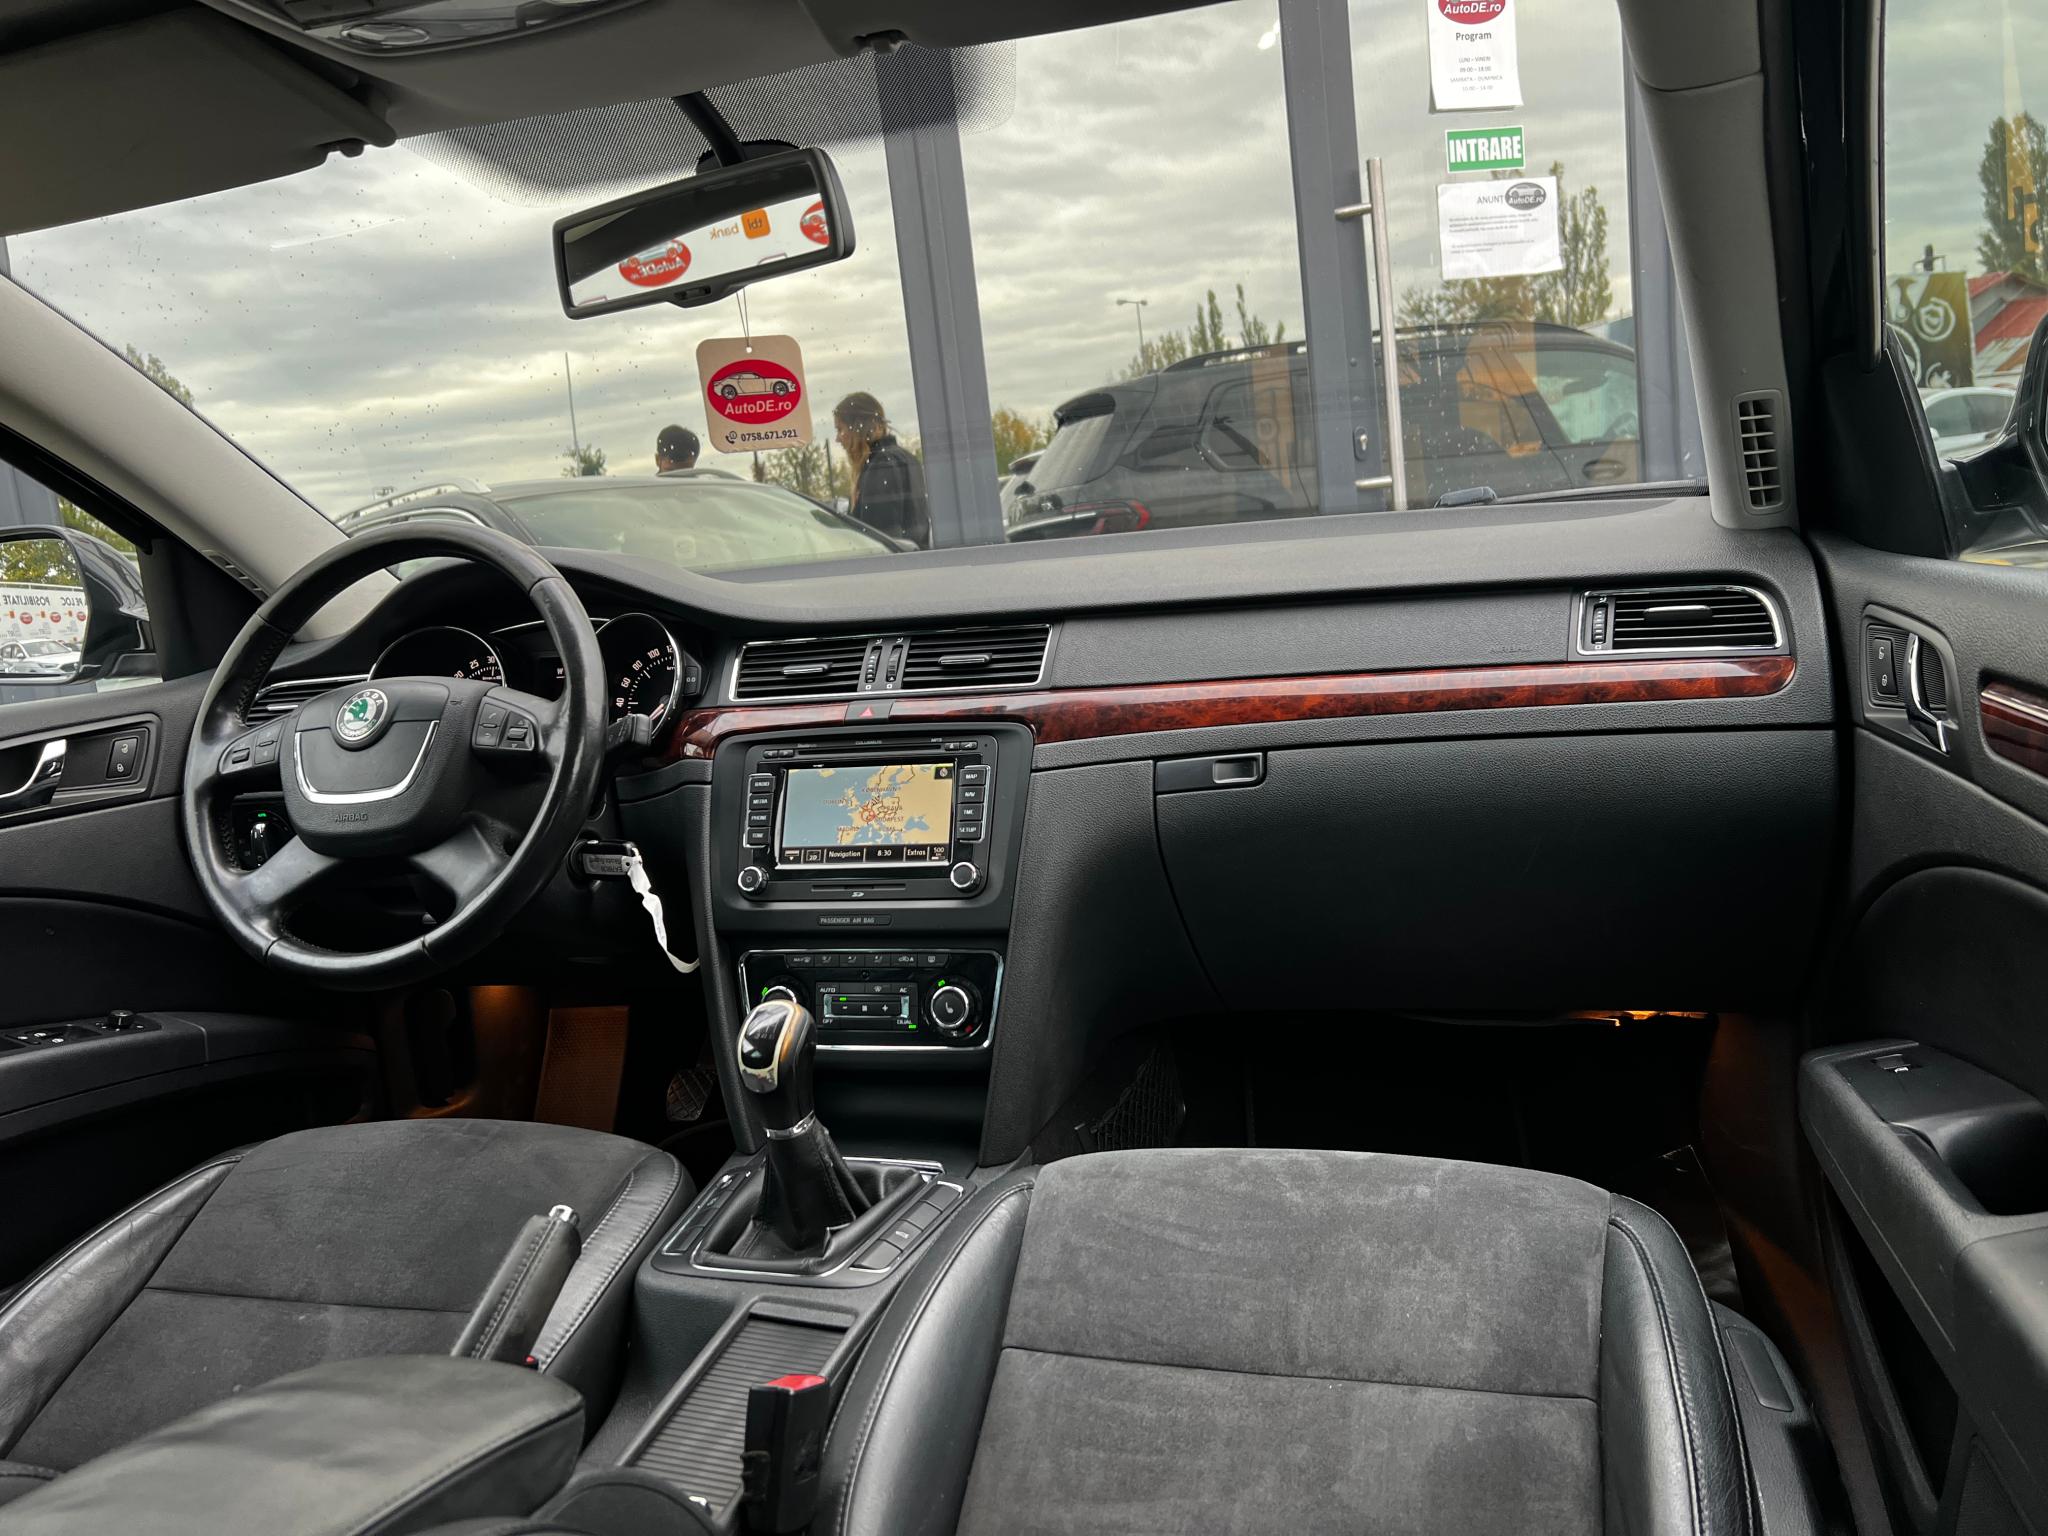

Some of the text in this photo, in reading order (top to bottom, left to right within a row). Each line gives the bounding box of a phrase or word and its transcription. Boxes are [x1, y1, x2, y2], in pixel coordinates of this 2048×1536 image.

[1444, 2, 1502, 15] AutoDE.ro
[1455, 32, 1492, 42] Program
[1448, 136, 1522, 163] INTRARE
[724, 400, 792, 415] AutoDE.ro
[741, 429, 798, 442] 0758.671.921
[647, 648, 660, 659] 100
[469, 659, 480, 670] 25
[486, 655, 495, 664] 30
[632, 660, 643, 671] 80
[620, 677, 631, 688] 60
[615, 697, 625, 708] 40
[334, 812, 368, 823] AIRBAG
[828, 850, 861, 858] Navigation
